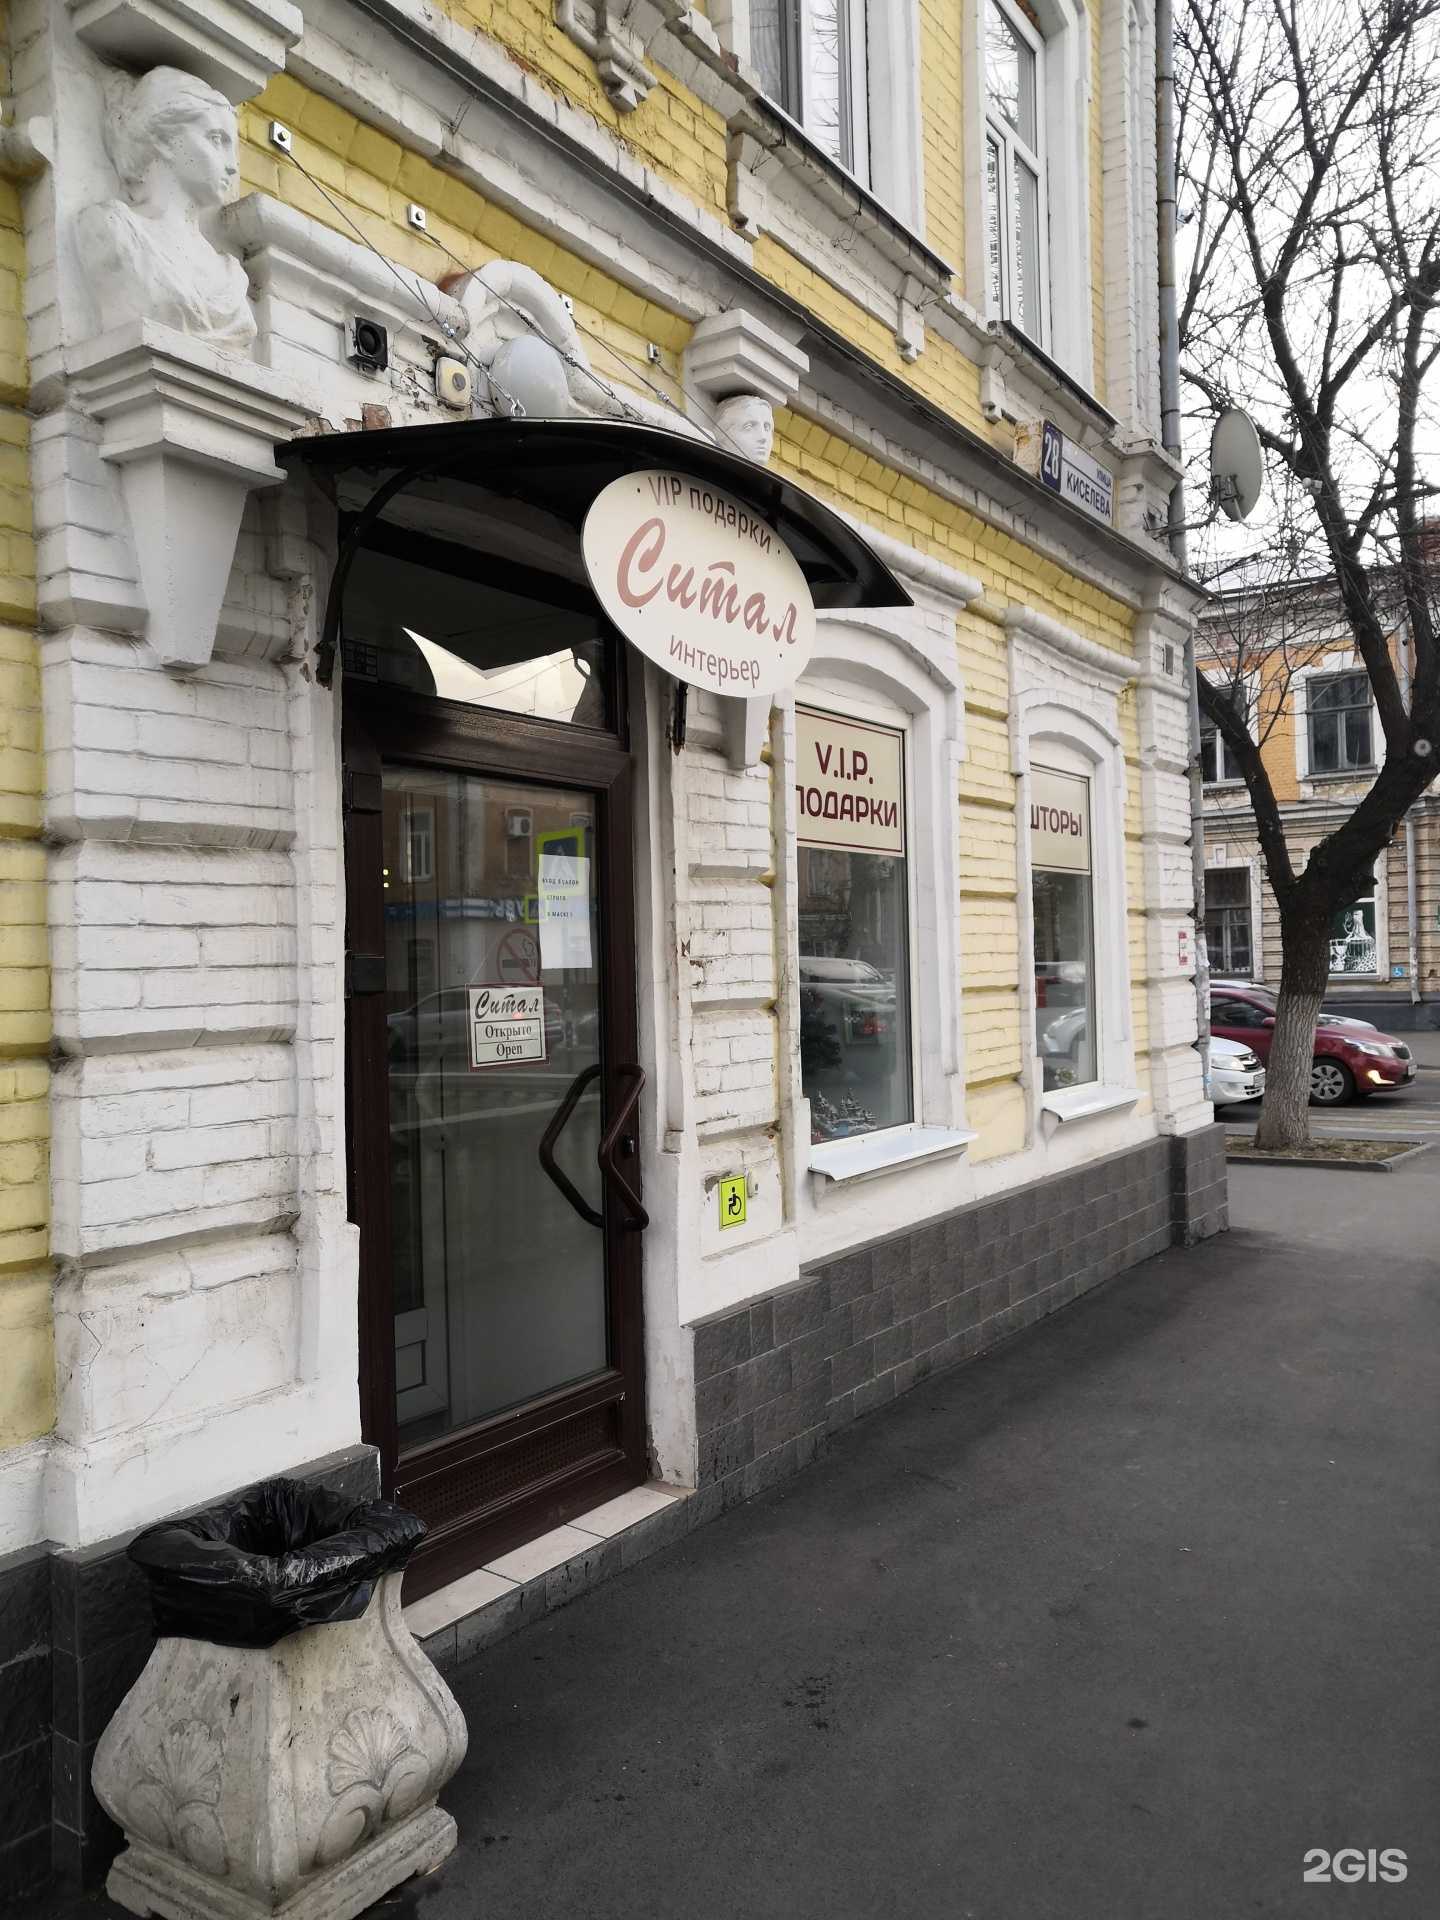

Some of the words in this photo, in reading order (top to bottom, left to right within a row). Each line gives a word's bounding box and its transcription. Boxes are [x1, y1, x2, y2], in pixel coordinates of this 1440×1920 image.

[1044, 432, 1059, 480] 28
[648, 476, 682, 506] VIP
[690, 487, 771, 554] подарки
[1066, 471, 1111, 518] КИСЕЛЕВА
[616, 517, 797, 645] Ситал
[669, 635, 760, 689] интерьер
[815, 741, 874, 785] V.I.P.
[475, 990, 539, 1019] Ситал
[485, 1025, 532, 1040] Открыто
[496, 1043, 523, 1058] Open
